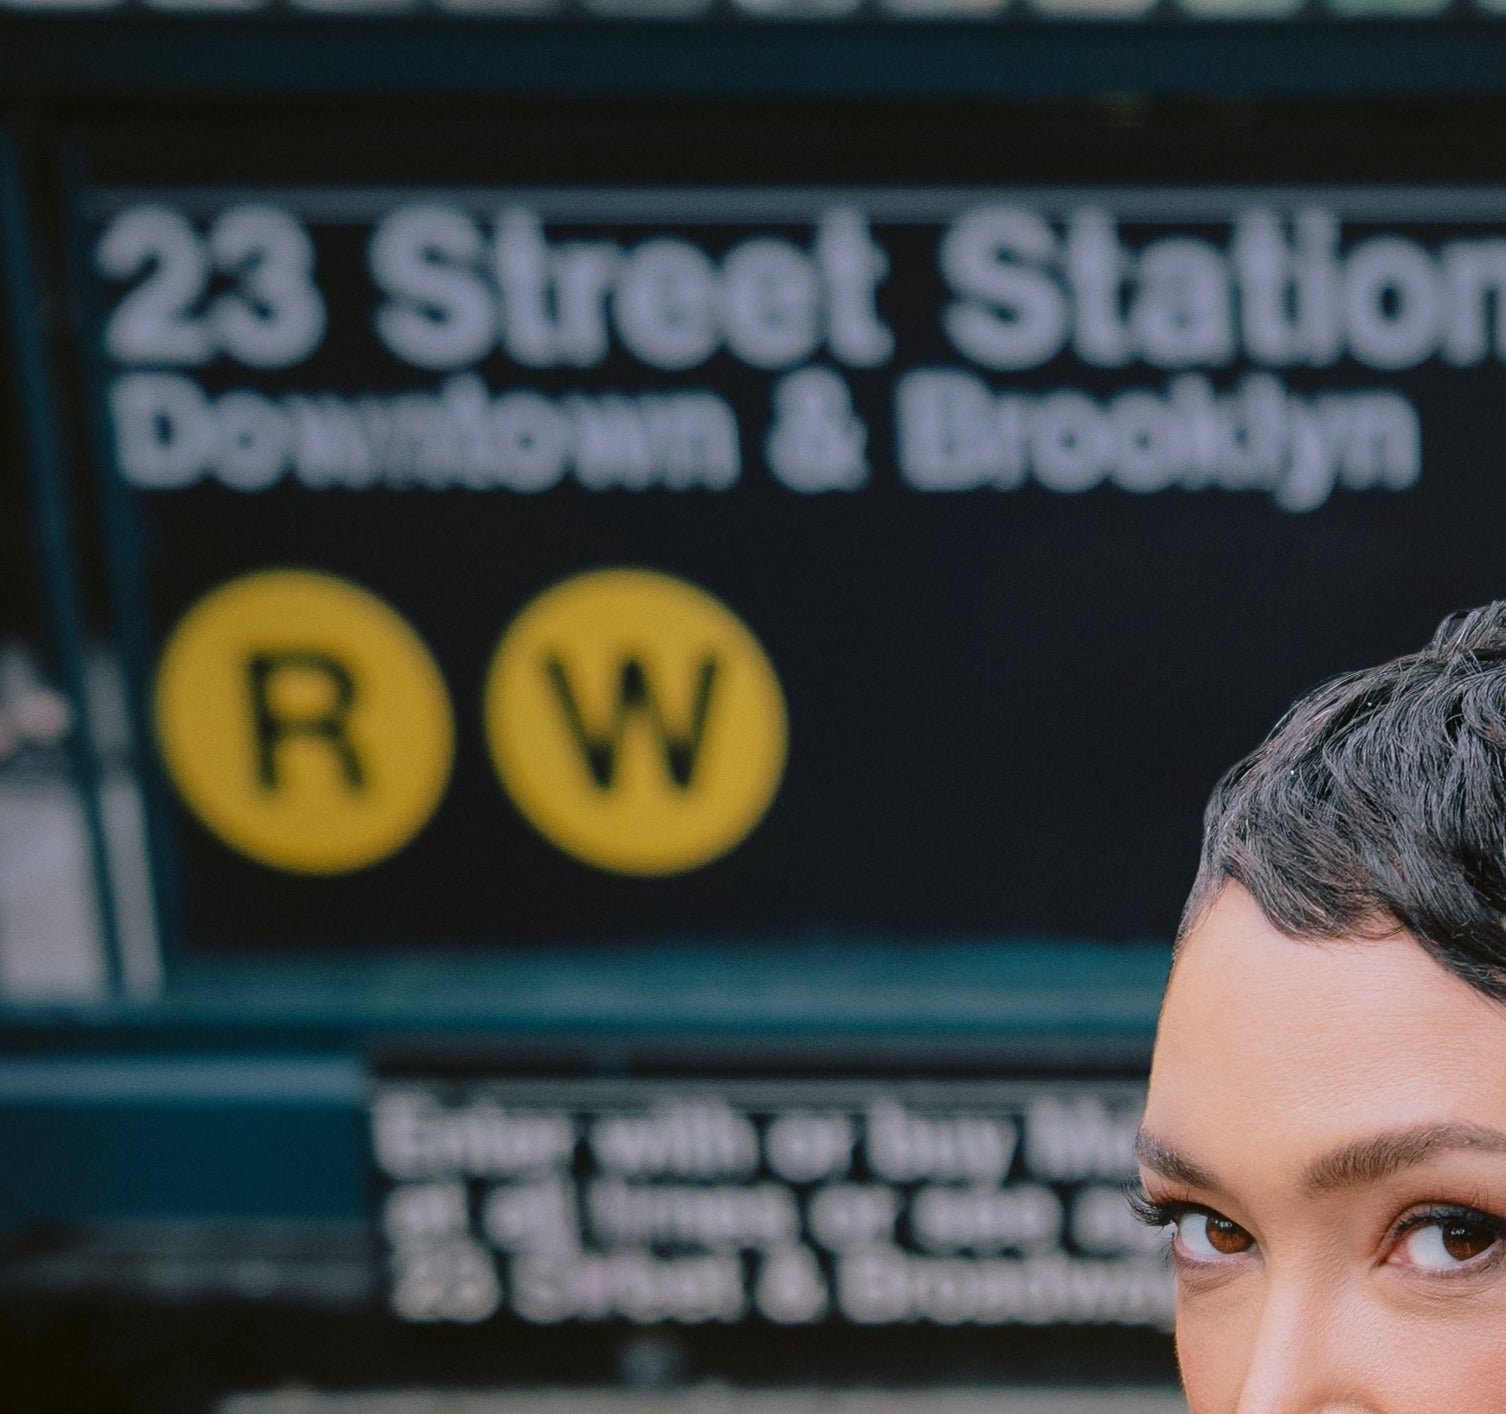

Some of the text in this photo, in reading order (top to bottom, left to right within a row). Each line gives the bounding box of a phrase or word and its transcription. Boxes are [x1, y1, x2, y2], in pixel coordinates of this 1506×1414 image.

[96, 204, 328, 368] 23
[367, 204, 894, 369] Street
[106, 365, 1423, 514] Downtown & Brooklyn
[246, 646, 720, 793] R W
